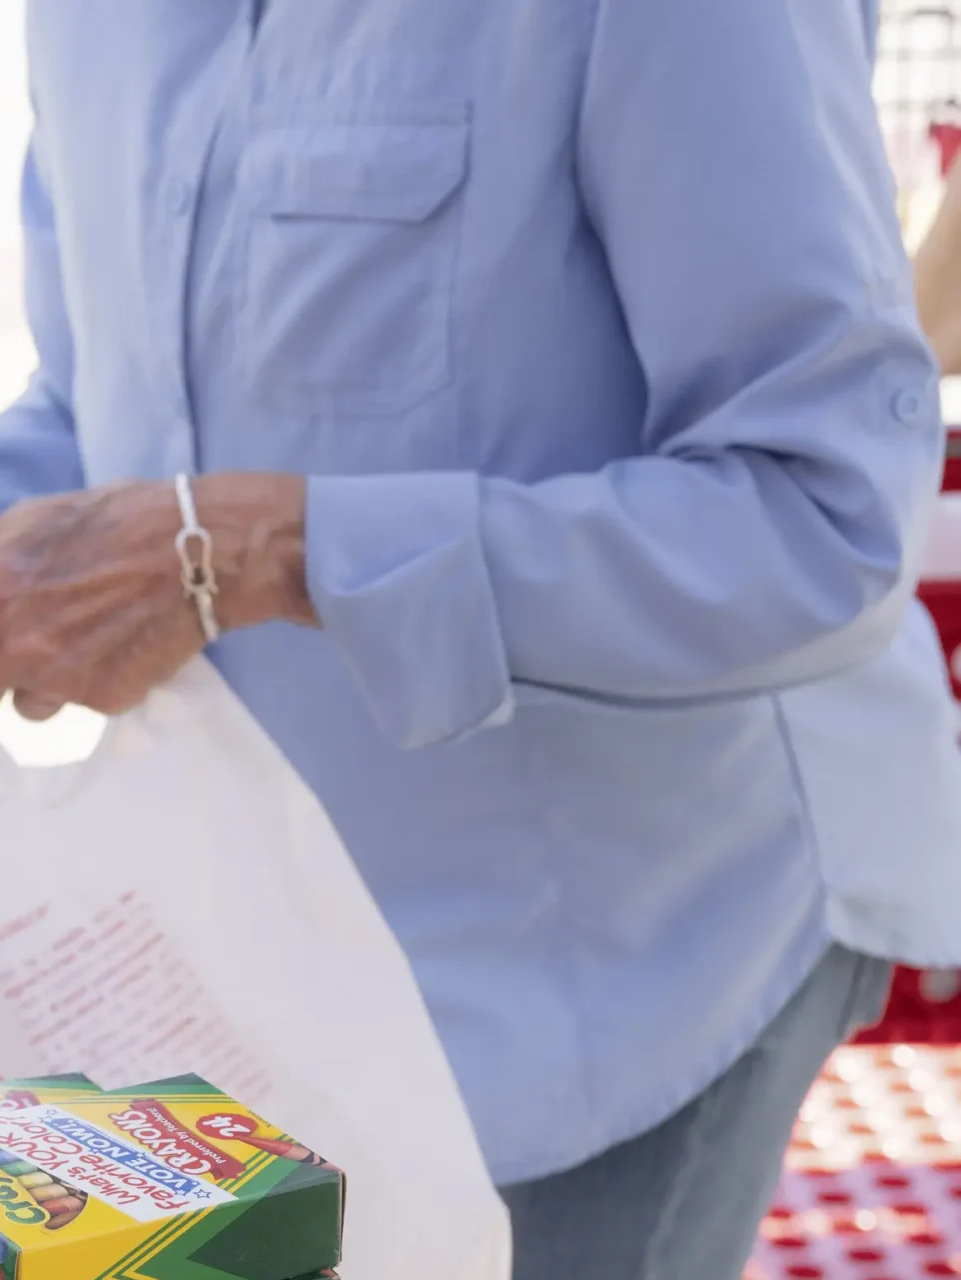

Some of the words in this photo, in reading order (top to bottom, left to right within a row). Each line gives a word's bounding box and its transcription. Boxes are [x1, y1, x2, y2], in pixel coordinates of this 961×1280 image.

[110, 1109, 212, 1175] CRAYONS
[202, 1115, 251, 1137] 24
[188, 1136, 225, 1165] Preferred
[67, 1166, 141, 1206] What's
[78, 1153, 191, 1210] Favorite
[127, 1156, 188, 1191] VOTE
